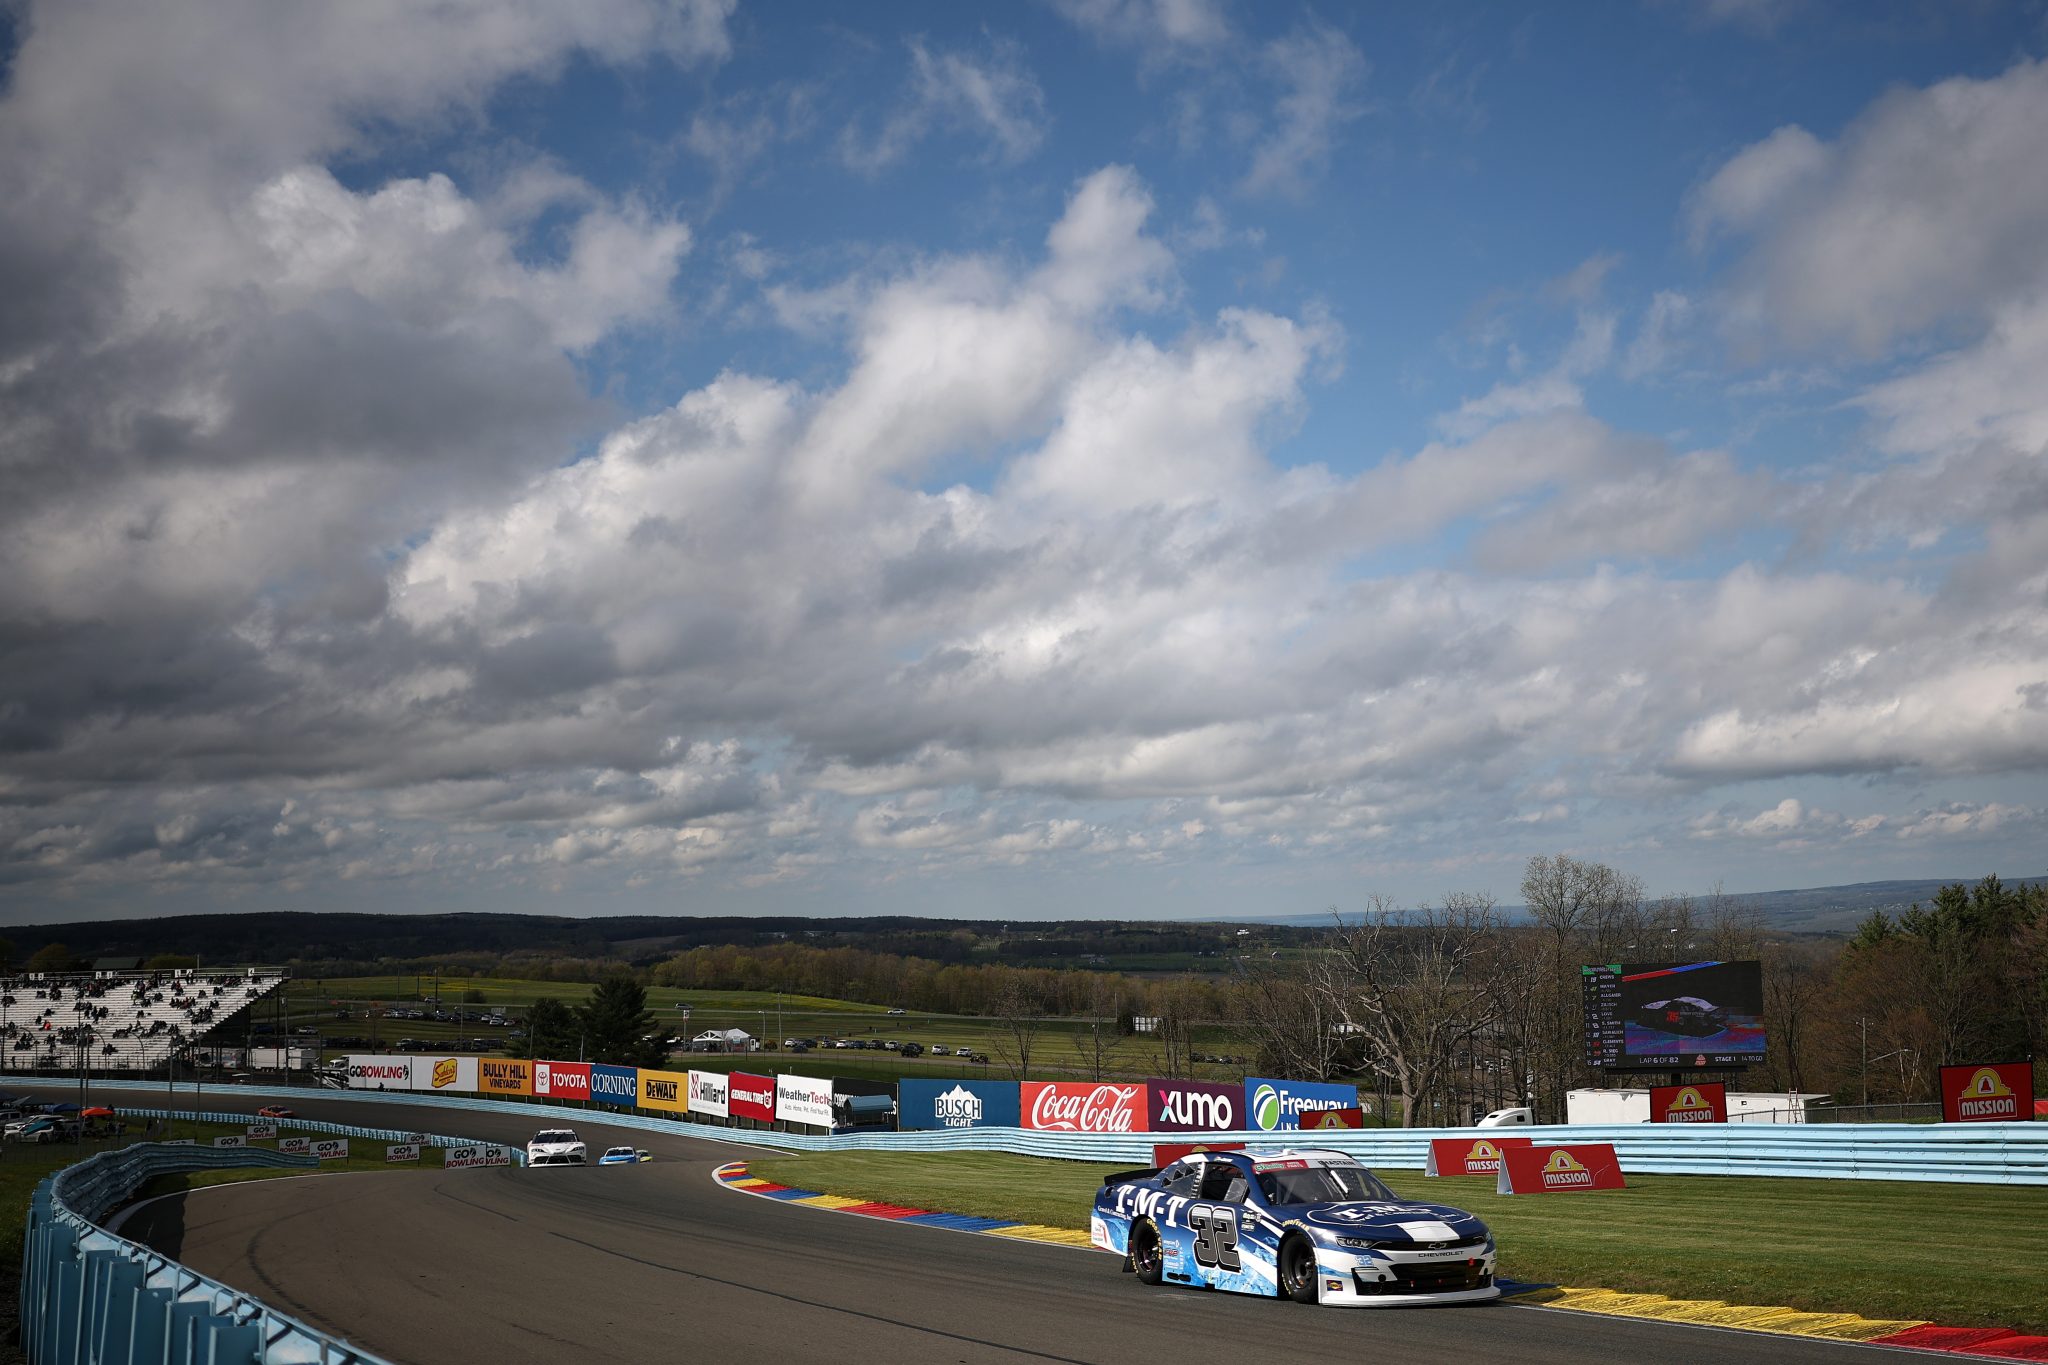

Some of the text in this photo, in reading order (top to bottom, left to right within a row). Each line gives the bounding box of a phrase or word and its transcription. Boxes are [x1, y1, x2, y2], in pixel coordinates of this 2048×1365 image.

[484, 1063, 527, 1079] BULLY HILL
[490, 1078, 521, 1089] VINEYARDS
[552, 1073, 587, 1089] TOYOTA
[591, 1074, 636, 1096] CORNING
[731, 1089, 764, 1104] GENERAL TIRE
[779, 1087, 830, 1105] WeatherTech
[936, 1098, 980, 1118] BUSCH
[1031, 1085, 1138, 1132] Coca-Cola
[1962, 1099, 2014, 1116] MISSION
[945, 1118, 972, 1127] LIGHT
[1668, 1110, 1712, 1122] MISSION
[317, 1143, 332, 1151] GO
[454, 1150, 469, 1159] GO
[446, 1158, 485, 1168] BOWLING
[1545, 1172, 1590, 1185] MISSION
[1190, 1204, 1241, 1273] 32
[1356, 1255, 1374, 1266] 32
